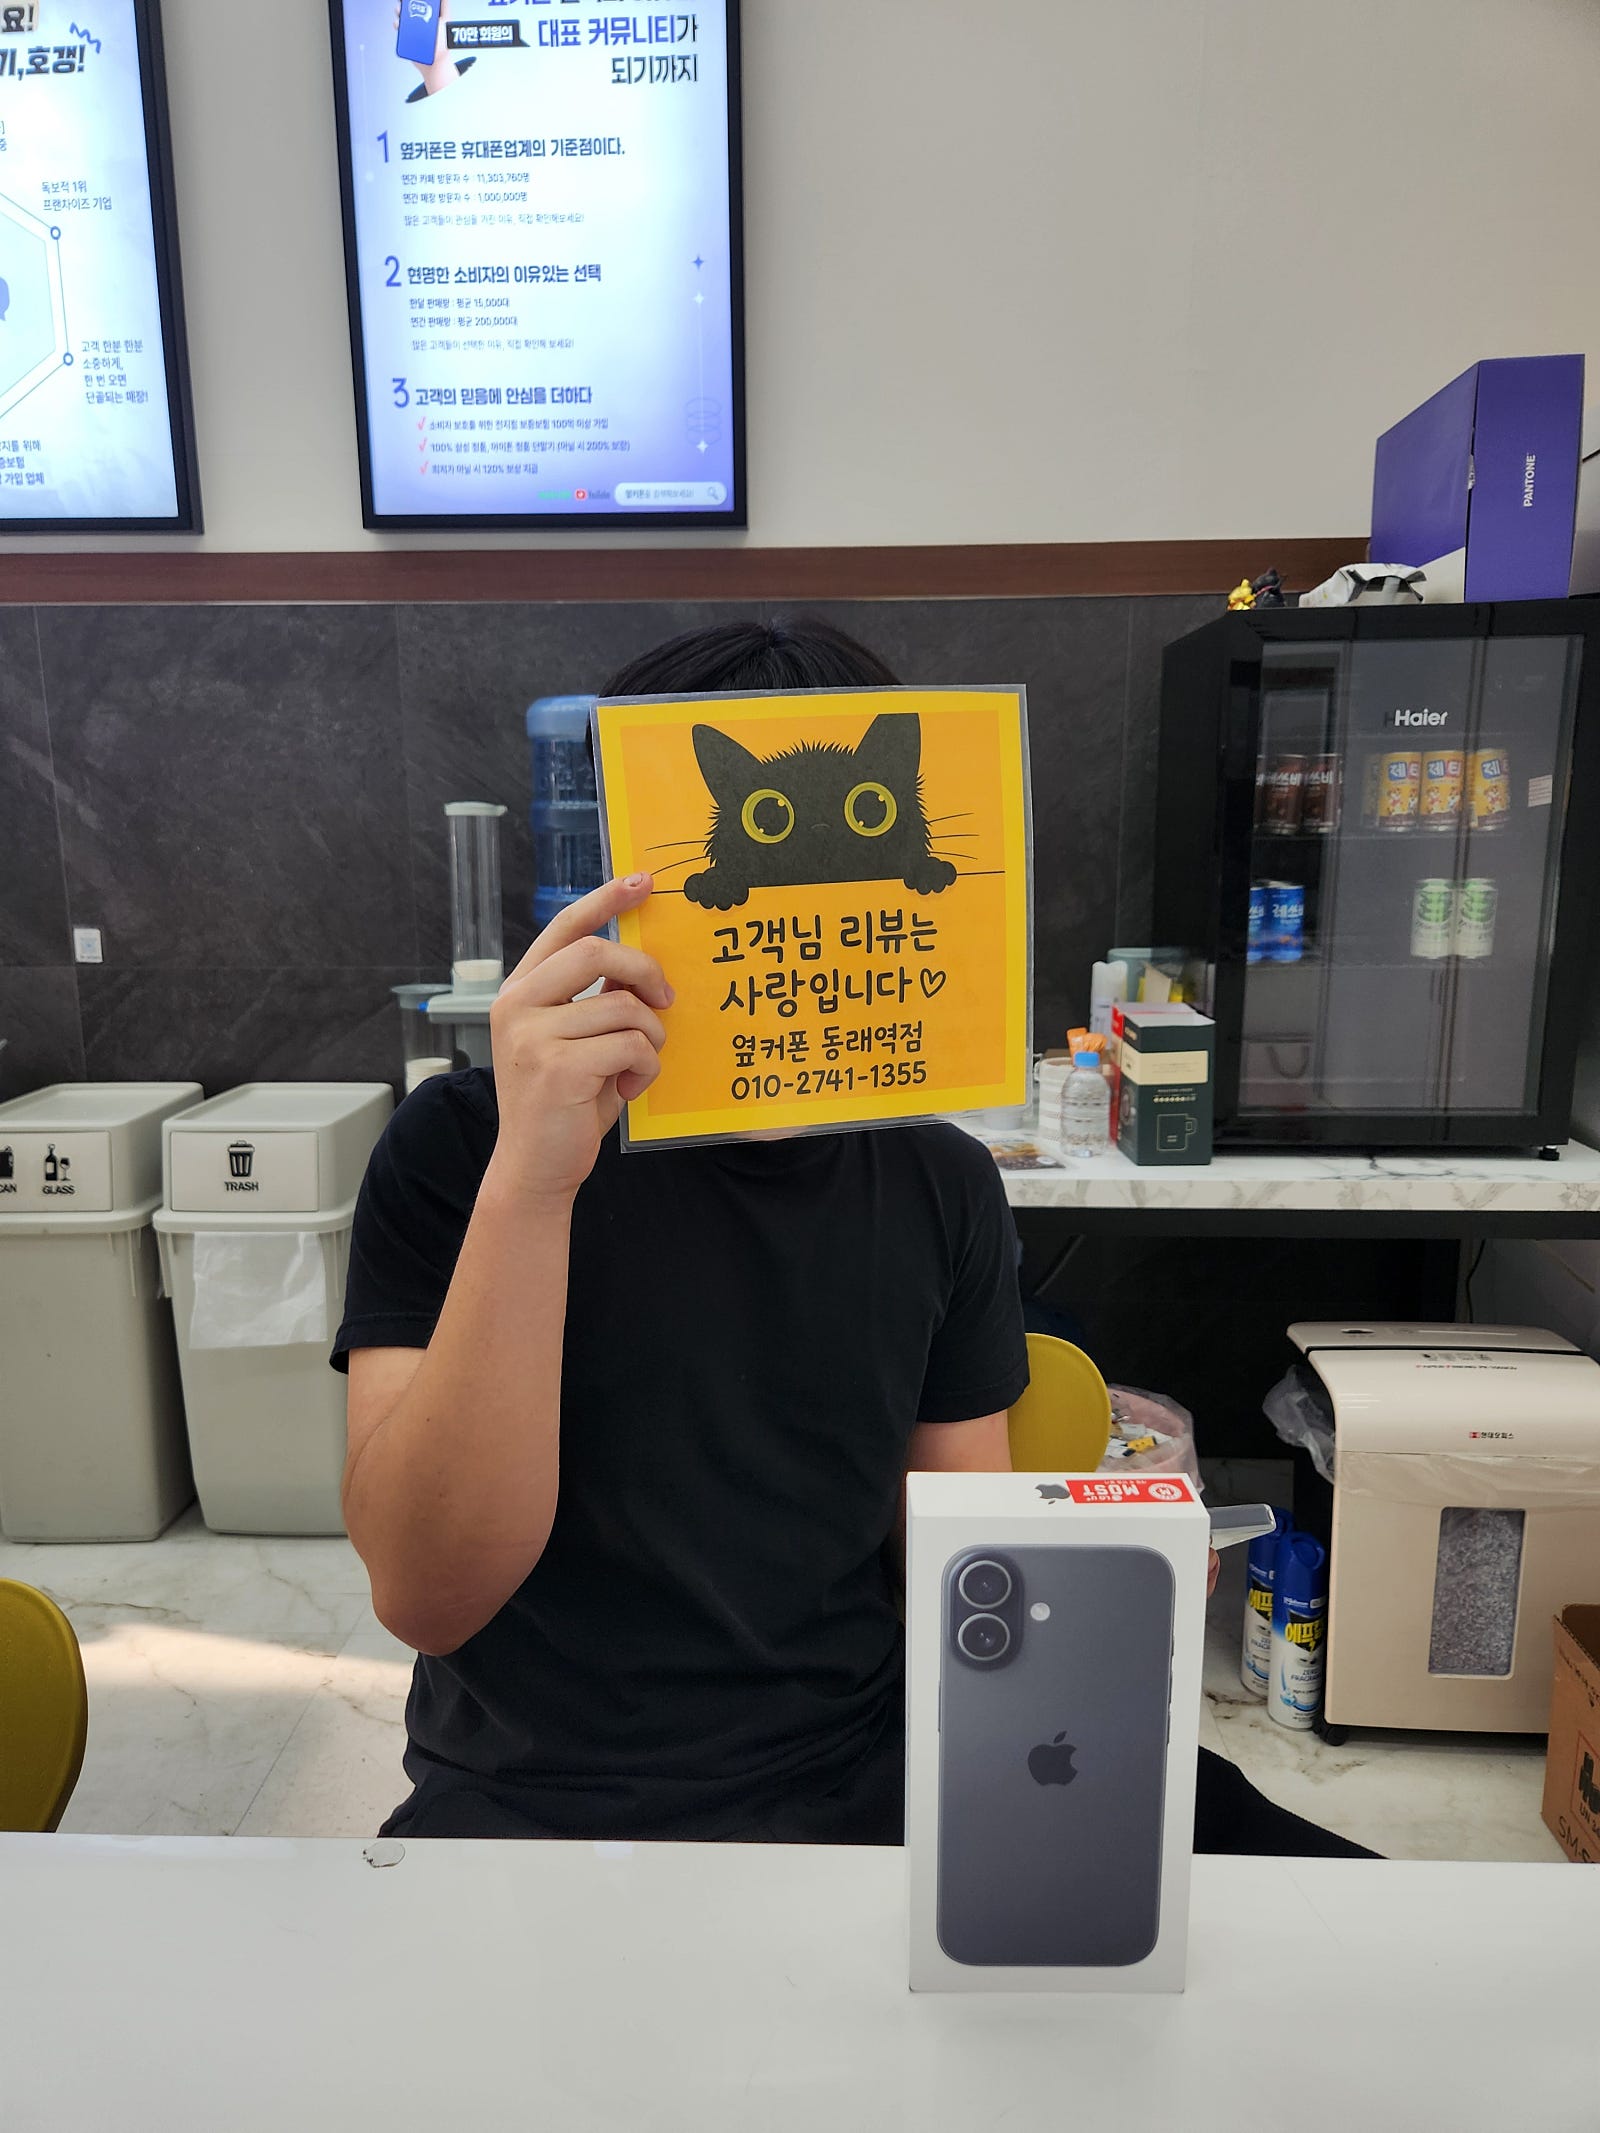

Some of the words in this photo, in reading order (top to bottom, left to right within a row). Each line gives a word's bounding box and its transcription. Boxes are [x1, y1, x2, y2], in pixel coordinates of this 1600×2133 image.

[0, 3, 35, 33] 요!
[451, 25, 479, 43] 70만
[479, 24, 514, 43] 회원의
[537, 18, 582, 48] 대표
[588, 14, 700, 47] 커뮤니티가
[611, 53, 698, 85] 되기까지
[376, 130, 390, 164] 1
[400, 140, 458, 161] 옆커폰은
[461, 138, 547, 160] 휴대폰업계의
[550, 136, 627, 158] 기준점이다.
[41, 180, 70, 194] 독보적
[72, 180, 88, 193] 1위
[92, 195, 113, 211] 기업
[384, 254, 402, 287] 2
[407, 266, 450, 286] 현명한
[454, 265, 510, 285] 소비자의
[514, 264, 570, 284] 이유있는
[573, 263, 602, 283] 선택
[81, 340, 101, 353] 고객
[391, 377, 410, 409] 3
[415, 388, 458, 406] 고객의
[460, 387, 502, 406] 믿음에
[506, 386, 547, 405] 안심을
[550, 385, 593, 404] 더하다
[4, 472, 24, 486] 가입
[1522, 453, 1537, 508] PANTONE
[1393, 707, 1449, 727] Haier
[710, 913, 824, 965] 고객님
[839, 908, 939, 956] 리뷰는
[718, 965, 913, 1019] 사랑입니다
[731, 1029, 811, 1068] 옆커폰
[820, 1020, 925, 1062] 동래역점
[730, 1060, 928, 1101] 010-2741-1355
[41, 1184, 76, 1196] GLASS
[224, 1180, 260, 1192] TRASH
[1082, 1483, 1141, 1497] MOST
